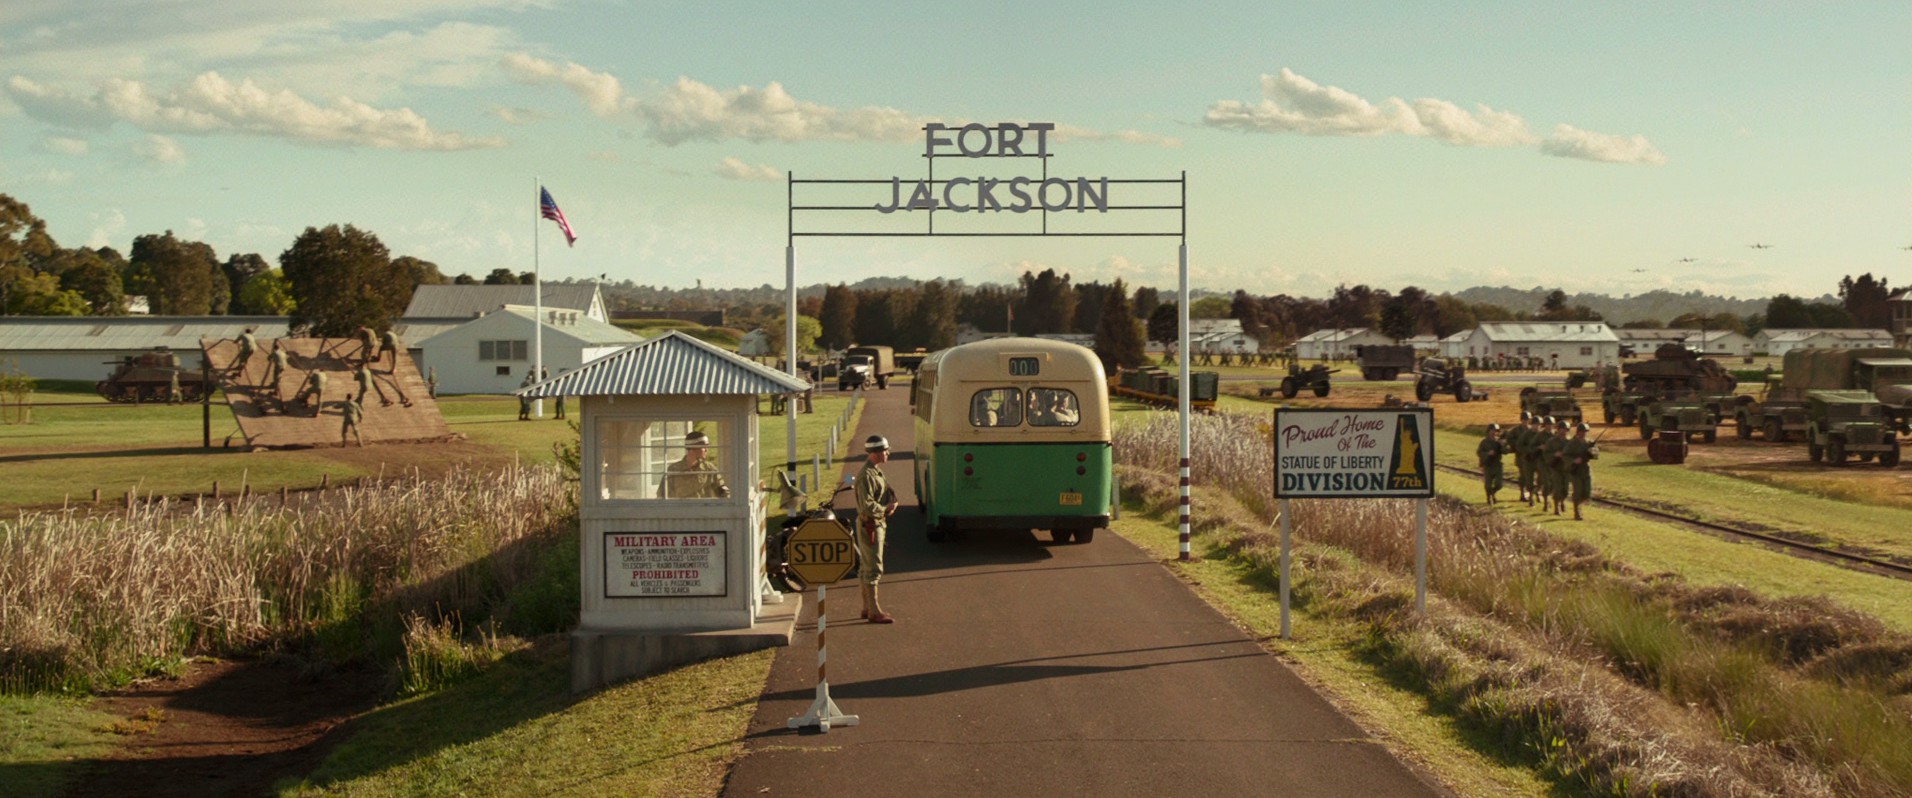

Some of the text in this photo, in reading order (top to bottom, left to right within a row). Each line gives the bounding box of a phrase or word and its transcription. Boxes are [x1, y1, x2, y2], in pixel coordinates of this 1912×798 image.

[926, 122, 1055, 159] FORT
[874, 176, 1108, 214] JACKSON
[1281, 414, 1385, 449] Proud Home
[1337, 434, 1377, 452] Of The
[1281, 456, 1385, 470] STATUE OF LIBERTY
[1282, 472, 1386, 491] DIVISION
[1392, 476, 1422, 488] 77th
[614, 535, 716, 547] MILITARY AREA
[794, 542, 849, 563] STOP
[632, 570, 699, 579] PROHIBITED
